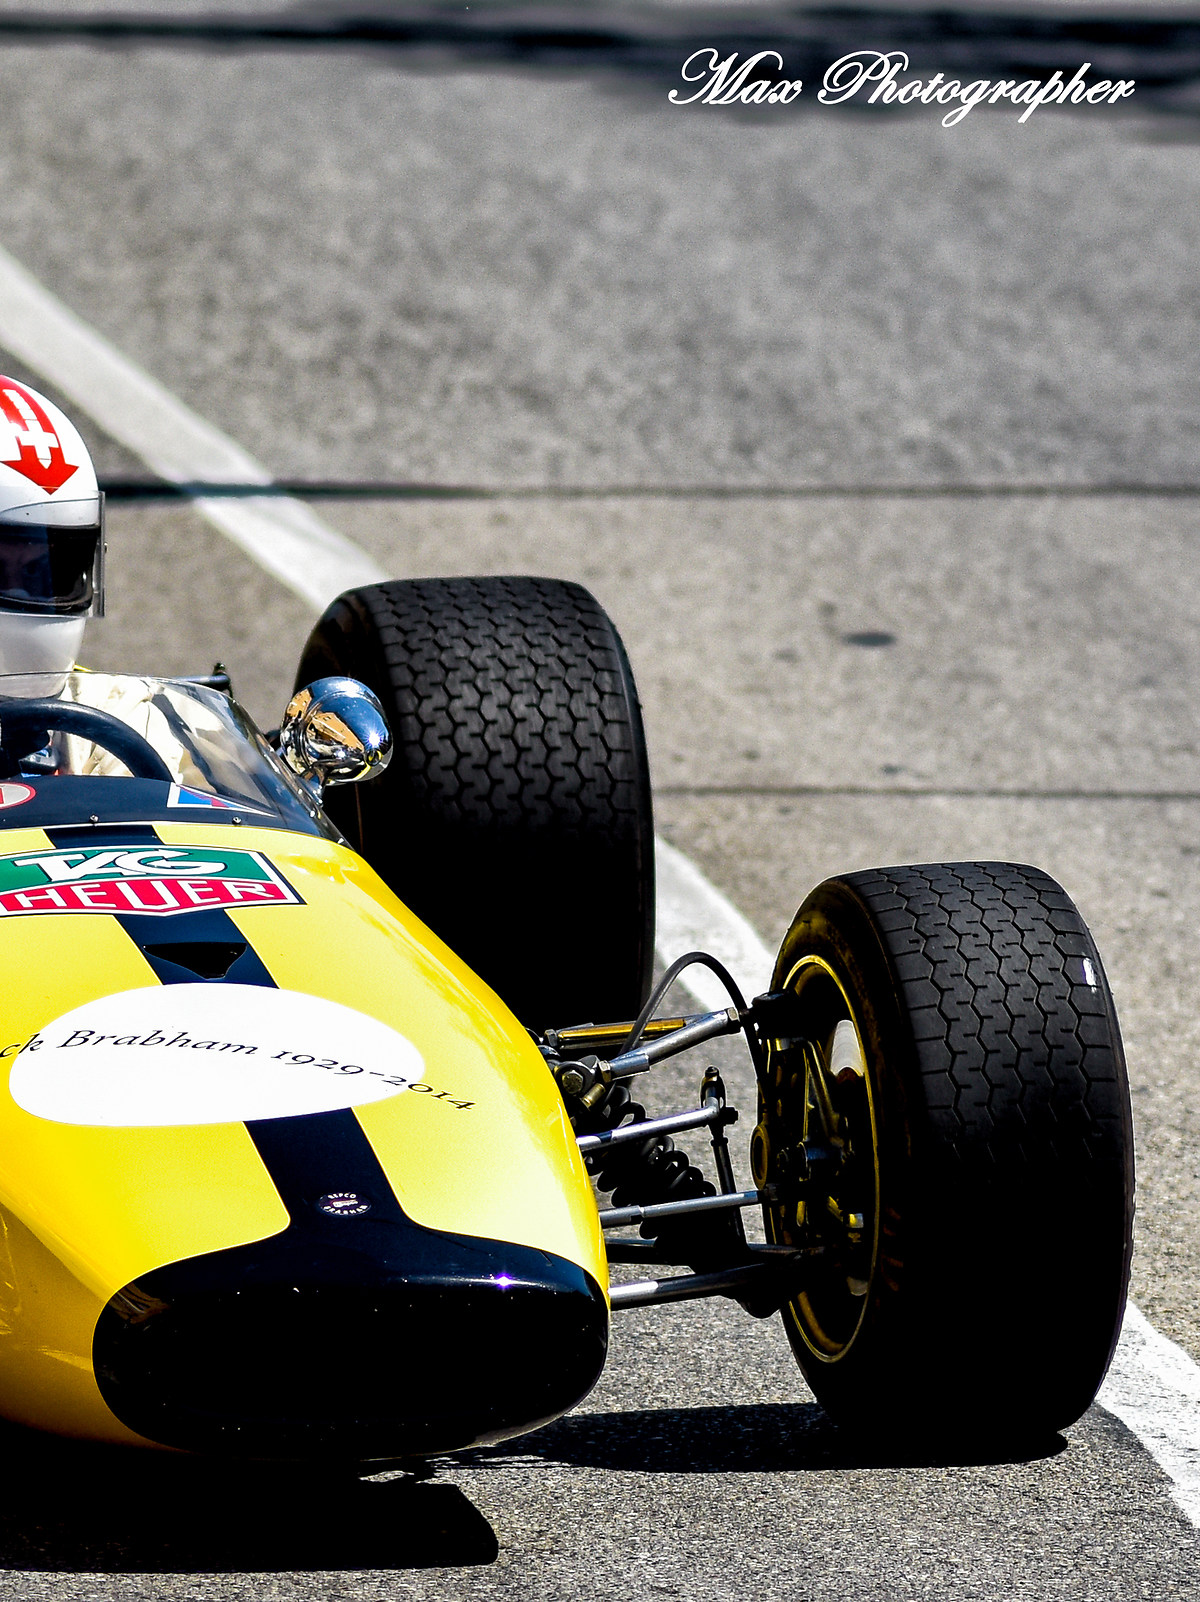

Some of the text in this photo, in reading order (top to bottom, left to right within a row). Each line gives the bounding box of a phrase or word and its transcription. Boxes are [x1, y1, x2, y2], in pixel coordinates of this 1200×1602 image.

[12, 848, 228, 882] TAG
[14, 879, 276, 911] HEUER
[56, 1029, 258, 1055] Brabham
[270, 1050, 477, 1110] 1929-2014
